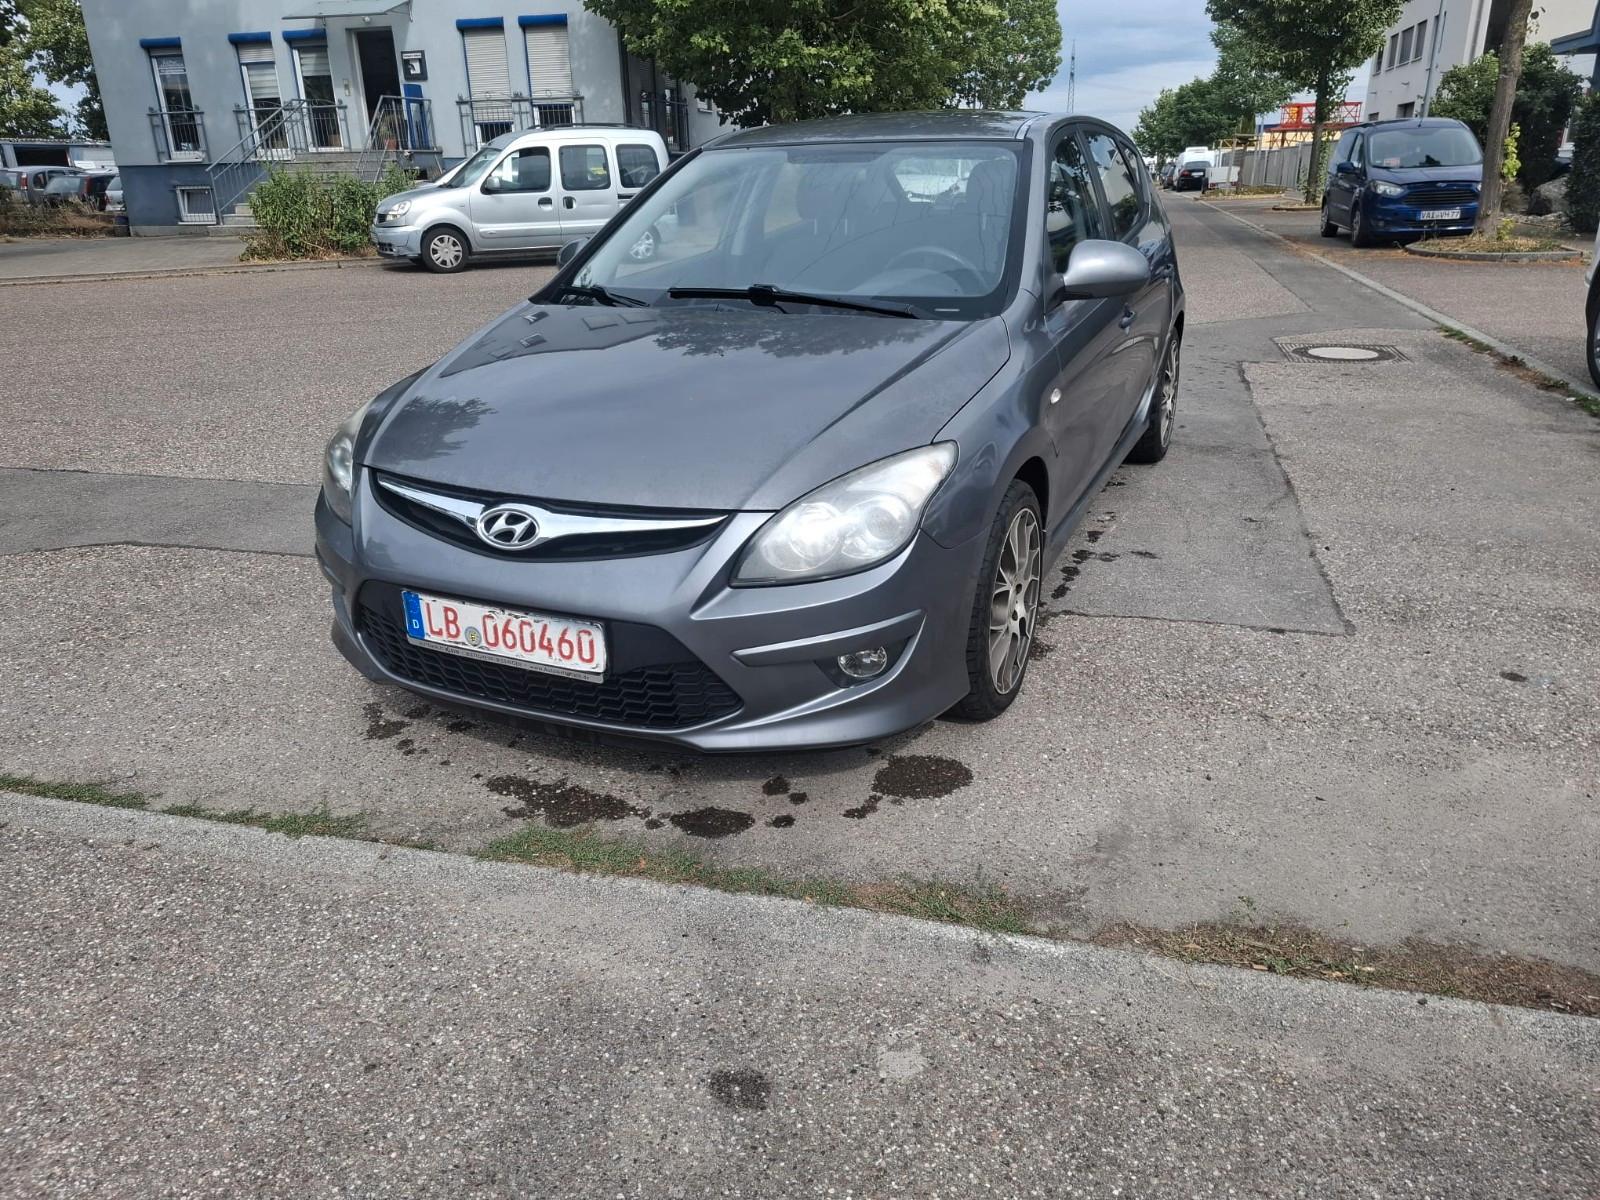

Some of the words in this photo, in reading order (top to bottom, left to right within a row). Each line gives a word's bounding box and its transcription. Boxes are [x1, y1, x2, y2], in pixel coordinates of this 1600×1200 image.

[412, 619, 420, 629] D
[425, 602, 461, 639] LB
[482, 614, 595, 664] 060460
